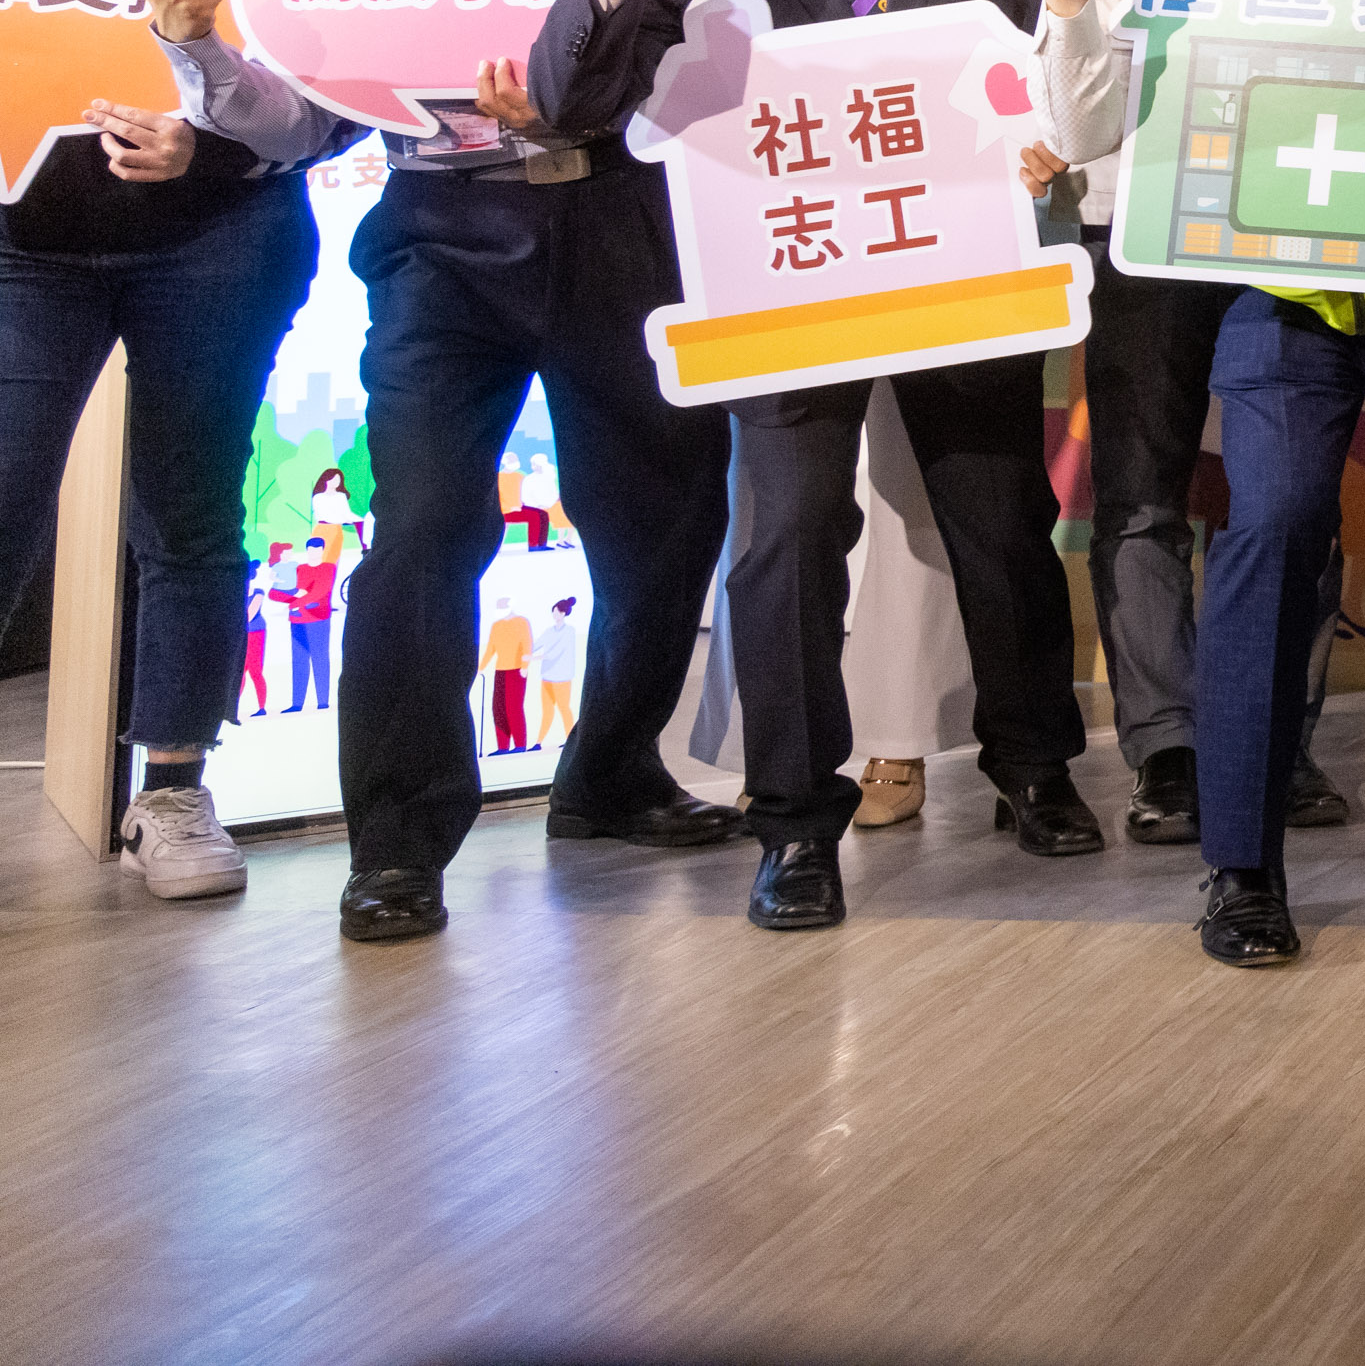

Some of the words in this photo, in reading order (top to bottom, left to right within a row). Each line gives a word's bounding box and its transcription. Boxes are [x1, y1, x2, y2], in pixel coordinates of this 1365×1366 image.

[306, 153, 387, 189] 元支
[750, 83, 924, 177] 社福
[764, 184, 938, 271] 志工
